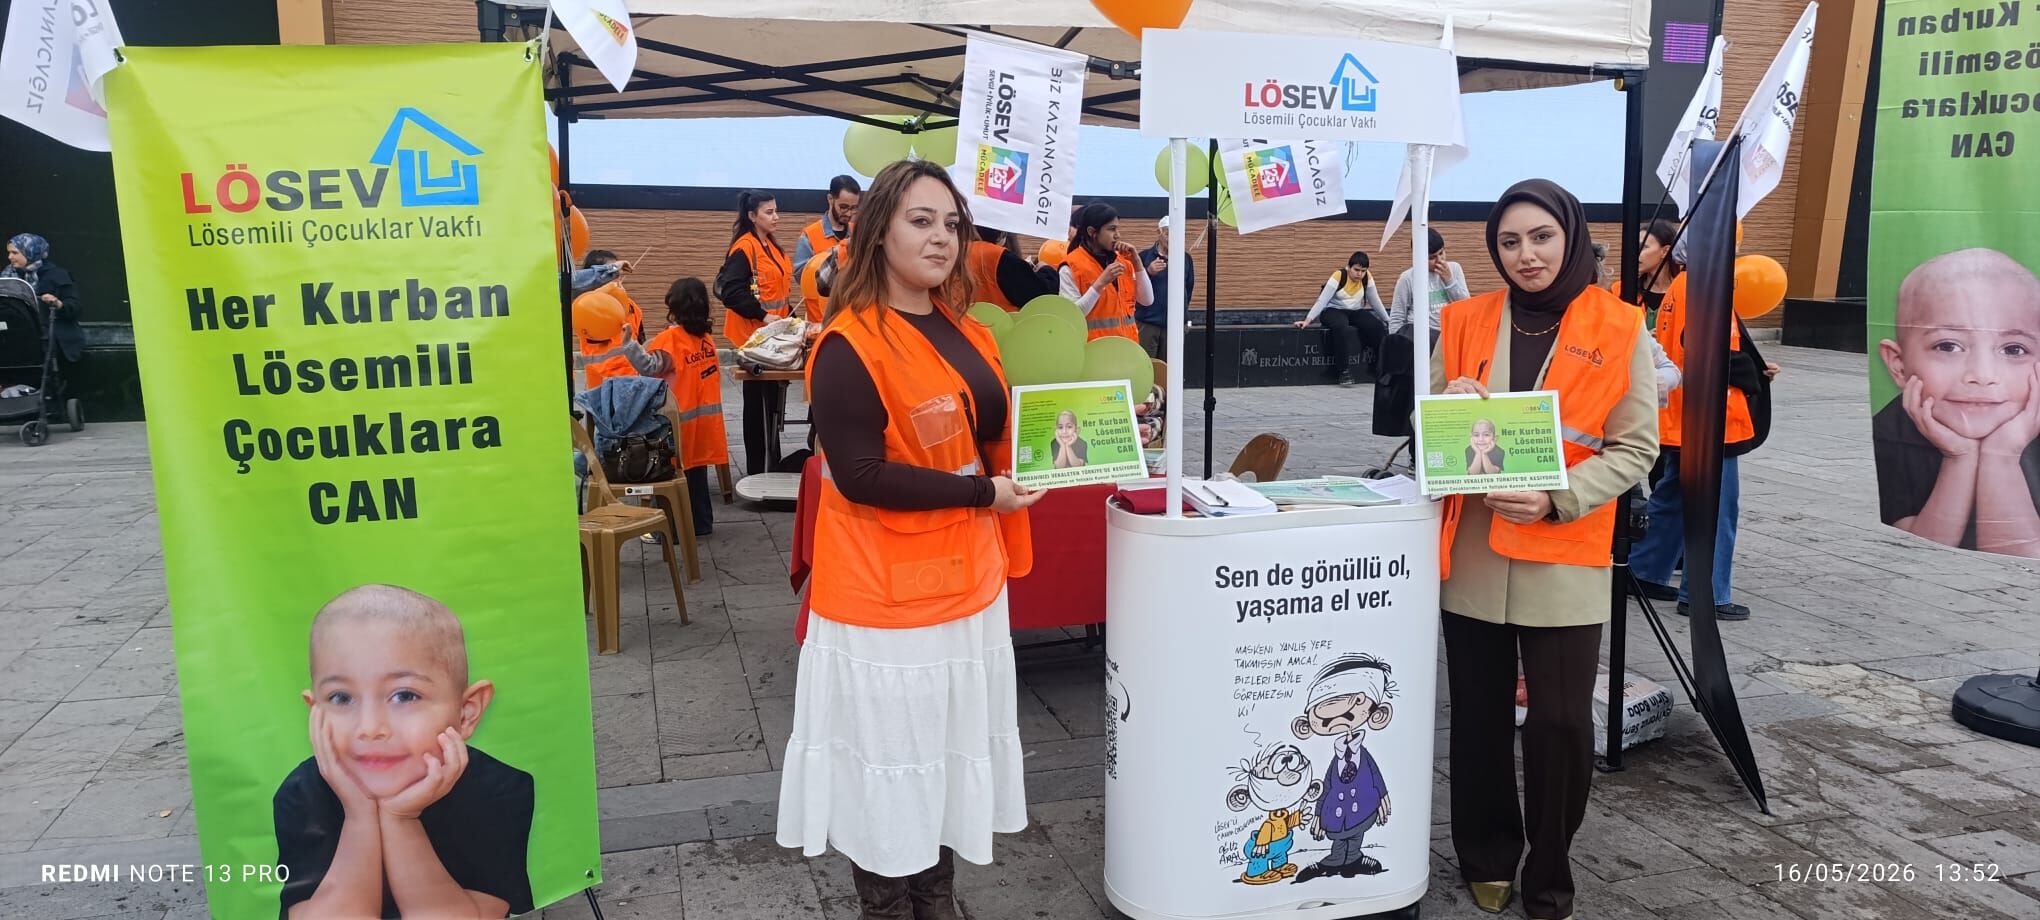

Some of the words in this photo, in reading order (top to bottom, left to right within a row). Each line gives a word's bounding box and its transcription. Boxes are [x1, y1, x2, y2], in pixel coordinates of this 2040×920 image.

[1244, 79, 1338, 110] LÖSEV
[993, 72, 1017, 144] LÖSEV
[1243, 111, 1294, 125] Lösemili
[1298, 113, 1347, 129] Çocuklar
[1350, 115, 1377, 129] Vakfı
[1036, 100, 1060, 227] KAZANACAĞIZ
[180, 163, 390, 215] LÖSEV
[188, 221, 294, 247] Lösemili
[302, 216, 414, 249] Çocuklar
[418, 214, 483, 239] Vakfı
[185, 286, 275, 332] Her
[300, 278, 510, 326] Kurban
[232, 342, 473, 396] Lösemili
[1259, 354, 1309, 367] ERZİNCAN
[1311, 353, 1360, 366] BELEESİ
[1082, 419, 1096, 427] Her
[1098, 416, 1129, 426] Kurban
[1095, 425, 1130, 436] Lösemili
[1501, 428, 1516, 436] Her
[1519, 427, 1552, 436] Kurban
[222, 412, 502, 474] Çocuklara
[1090, 436, 1132, 448] Çocuklara
[1116, 444, 1134, 453] CAN
[1508, 446, 1554, 457] Çocuklara
[1514, 436, 1553, 445] Lösemili
[1536, 455, 1555, 463] CAN
[308, 477, 419, 526] CAN
[1215, 565, 1258, 588] Sen
[1267, 563, 1294, 586] de
[1301, 555, 1381, 589] gönüllü
[1388, 553, 1410, 580] ol,
[1236, 594, 1323, 623] yaşama
[1330, 588, 1350, 611] el
[1357, 589, 1392, 610] ver.
[1311, 640, 1333, 650] YERE
